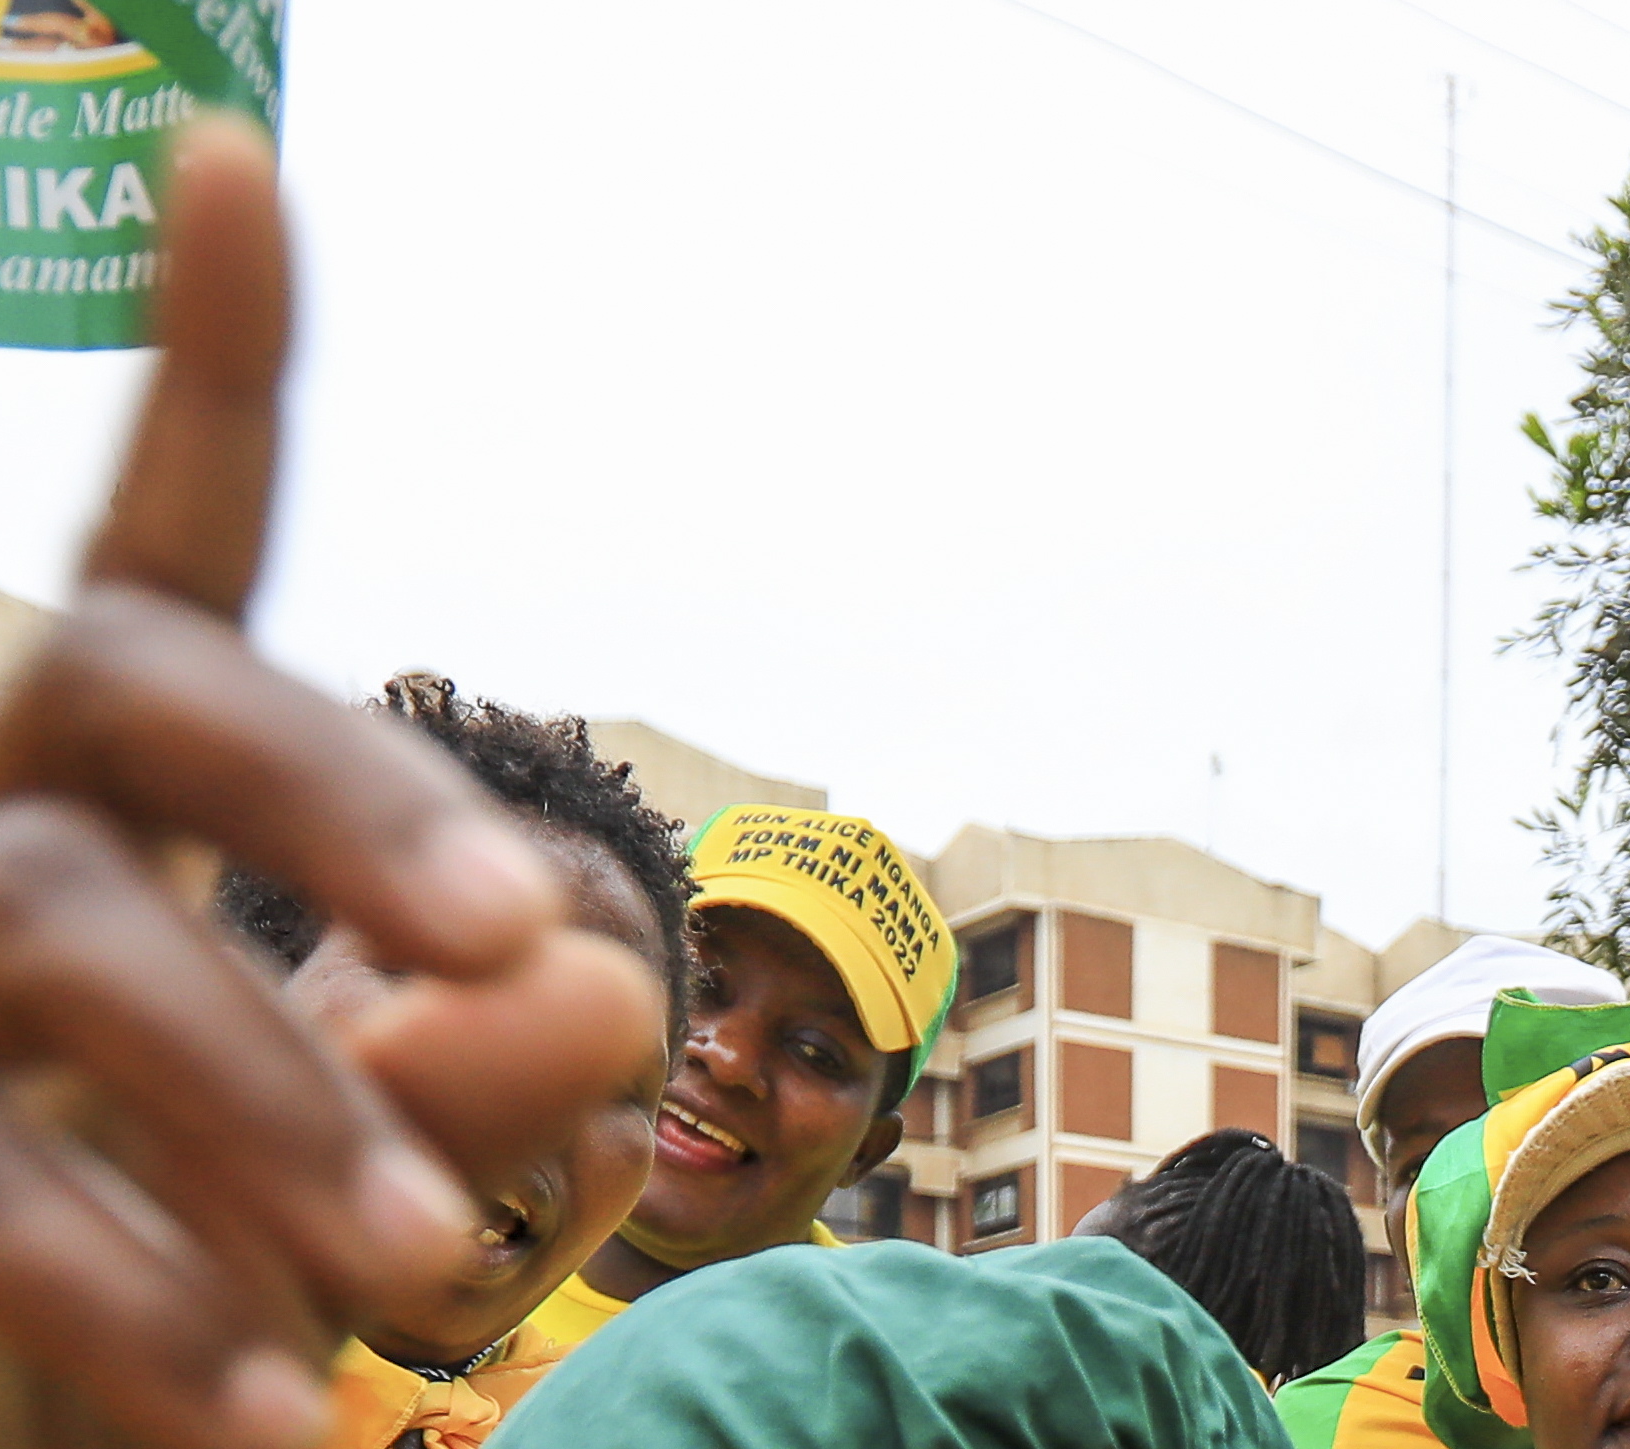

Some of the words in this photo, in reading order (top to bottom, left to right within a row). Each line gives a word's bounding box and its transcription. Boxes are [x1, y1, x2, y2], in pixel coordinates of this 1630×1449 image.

[725, 847, 772, 865] MP
[781, 850, 867, 911] THIKA
[869, 908, 918, 984] 2022
[732, 812, 789, 827] HON
[794, 818, 875, 848] ALICE
[873, 842, 940, 953] NGANGA
[734, 828, 823, 854] FORM
[829, 843, 864, 875] NI
[865, 873, 926, 966] MAMA
